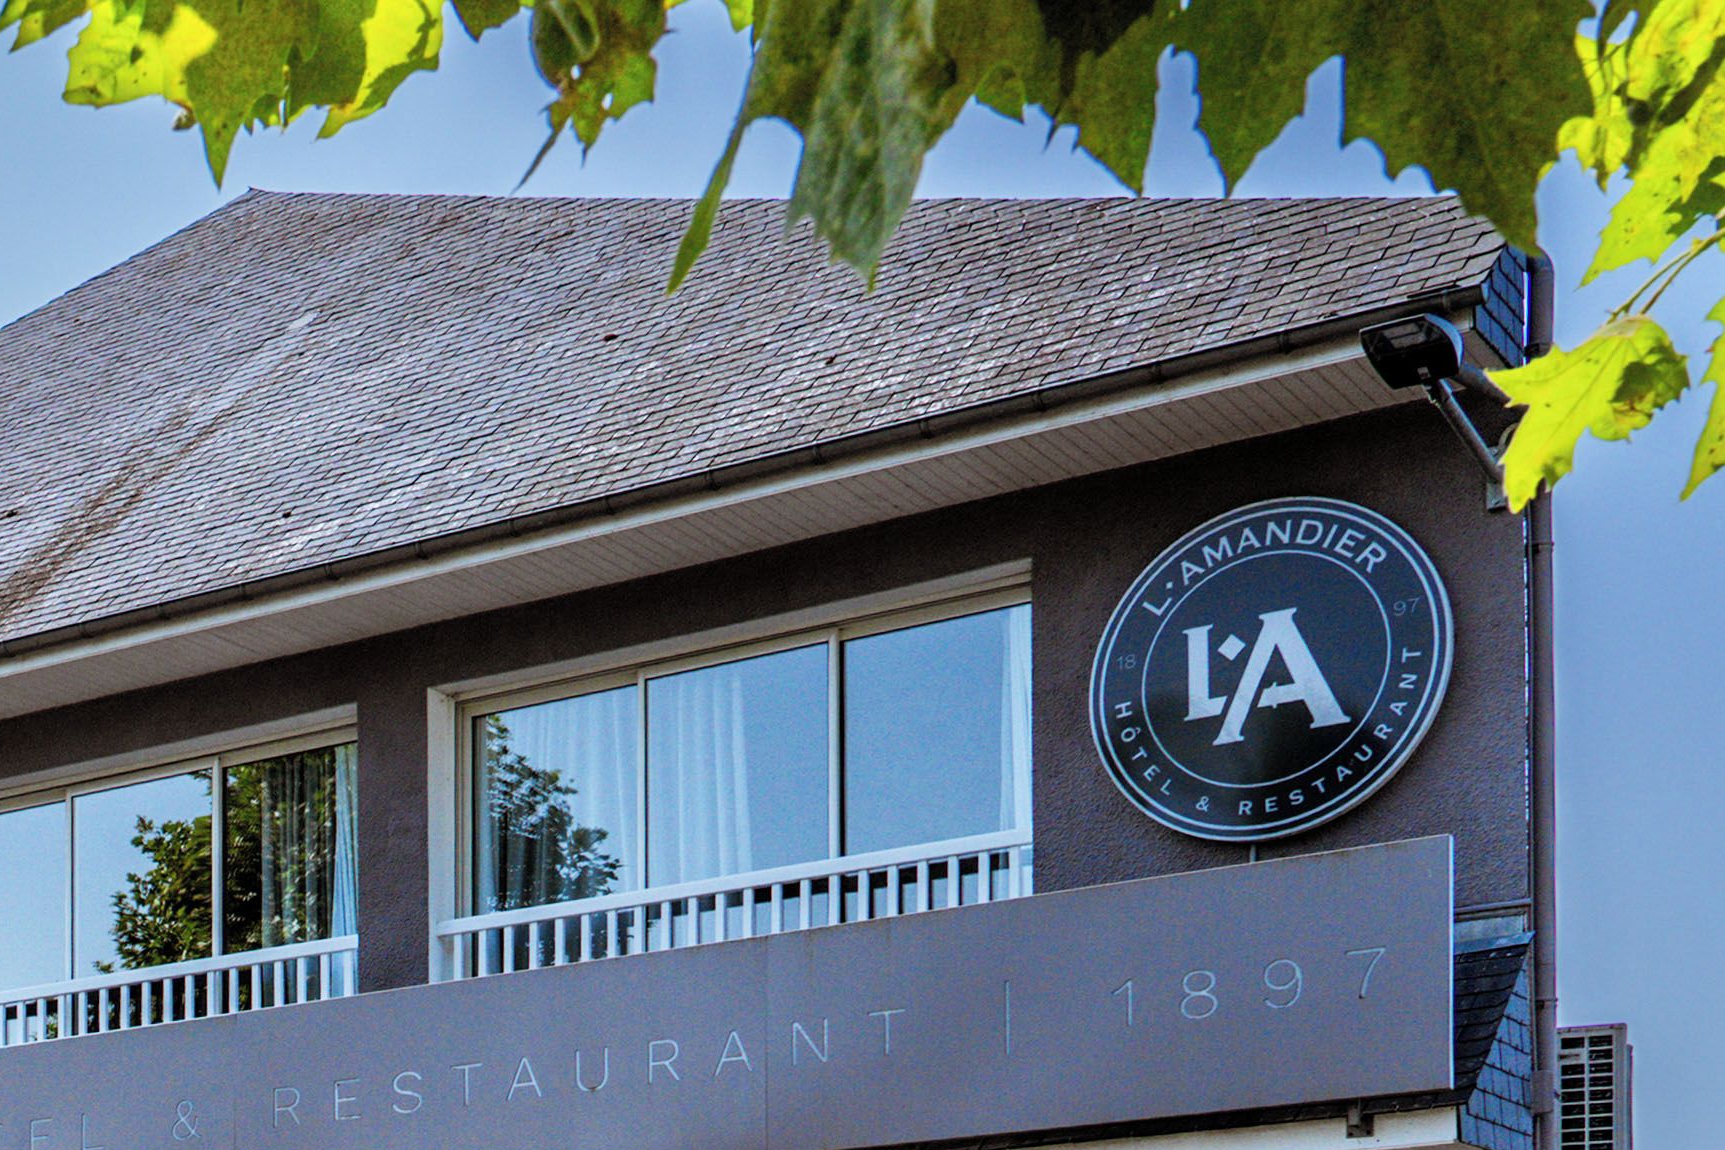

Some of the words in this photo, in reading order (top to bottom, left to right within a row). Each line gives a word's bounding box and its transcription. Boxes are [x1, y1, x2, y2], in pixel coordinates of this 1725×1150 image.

[1114, 701, 1172, 796] HÔTEL
[1195, 796, 1210, 812] &
[1237, 647, 1422, 817] RESTAURANT
[171, 1100, 202, 1140] &
[272, 1008, 906, 1129] RESTAURANT
[1109, 947, 1387, 1027] 1897
